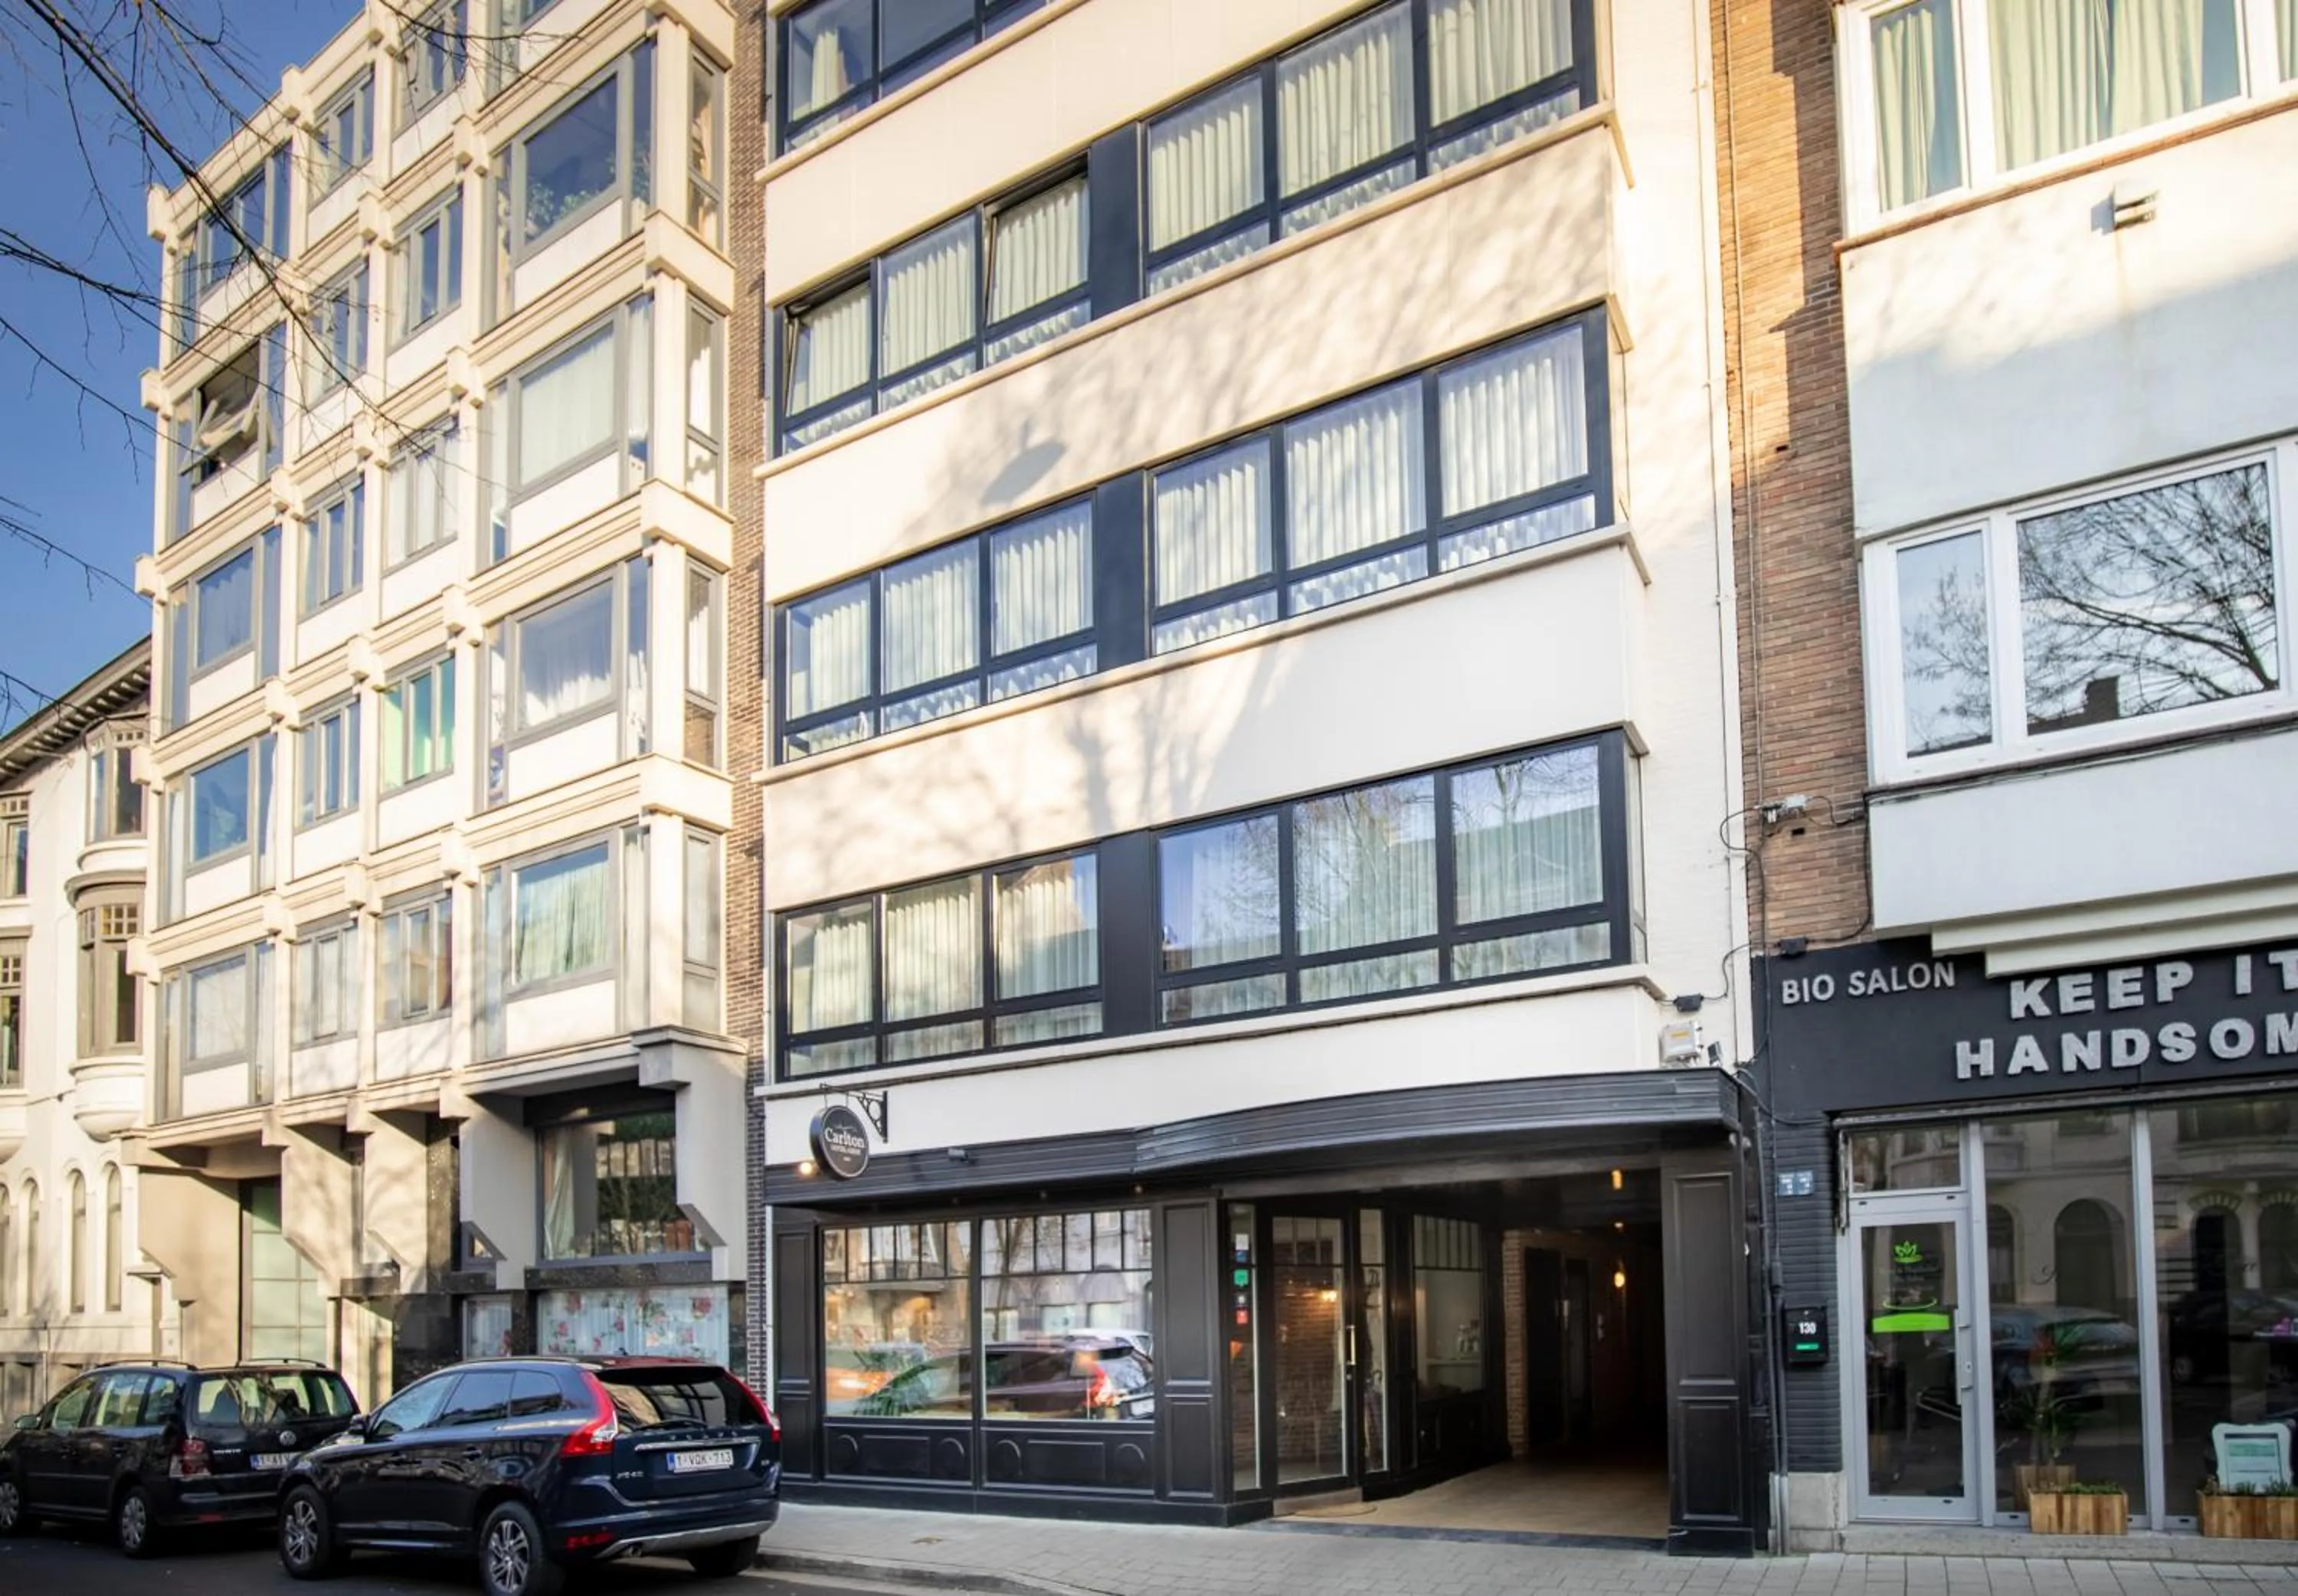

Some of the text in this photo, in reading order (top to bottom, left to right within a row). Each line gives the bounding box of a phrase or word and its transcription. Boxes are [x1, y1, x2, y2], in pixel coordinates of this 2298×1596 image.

[1782, 962, 1955, 1004] BIO SALON
[2010, 949, 2298, 1019] KEEP IT
[1956, 1012, 2298, 1079] HANDSOM
[825, 1127, 865, 1148] Carlton
